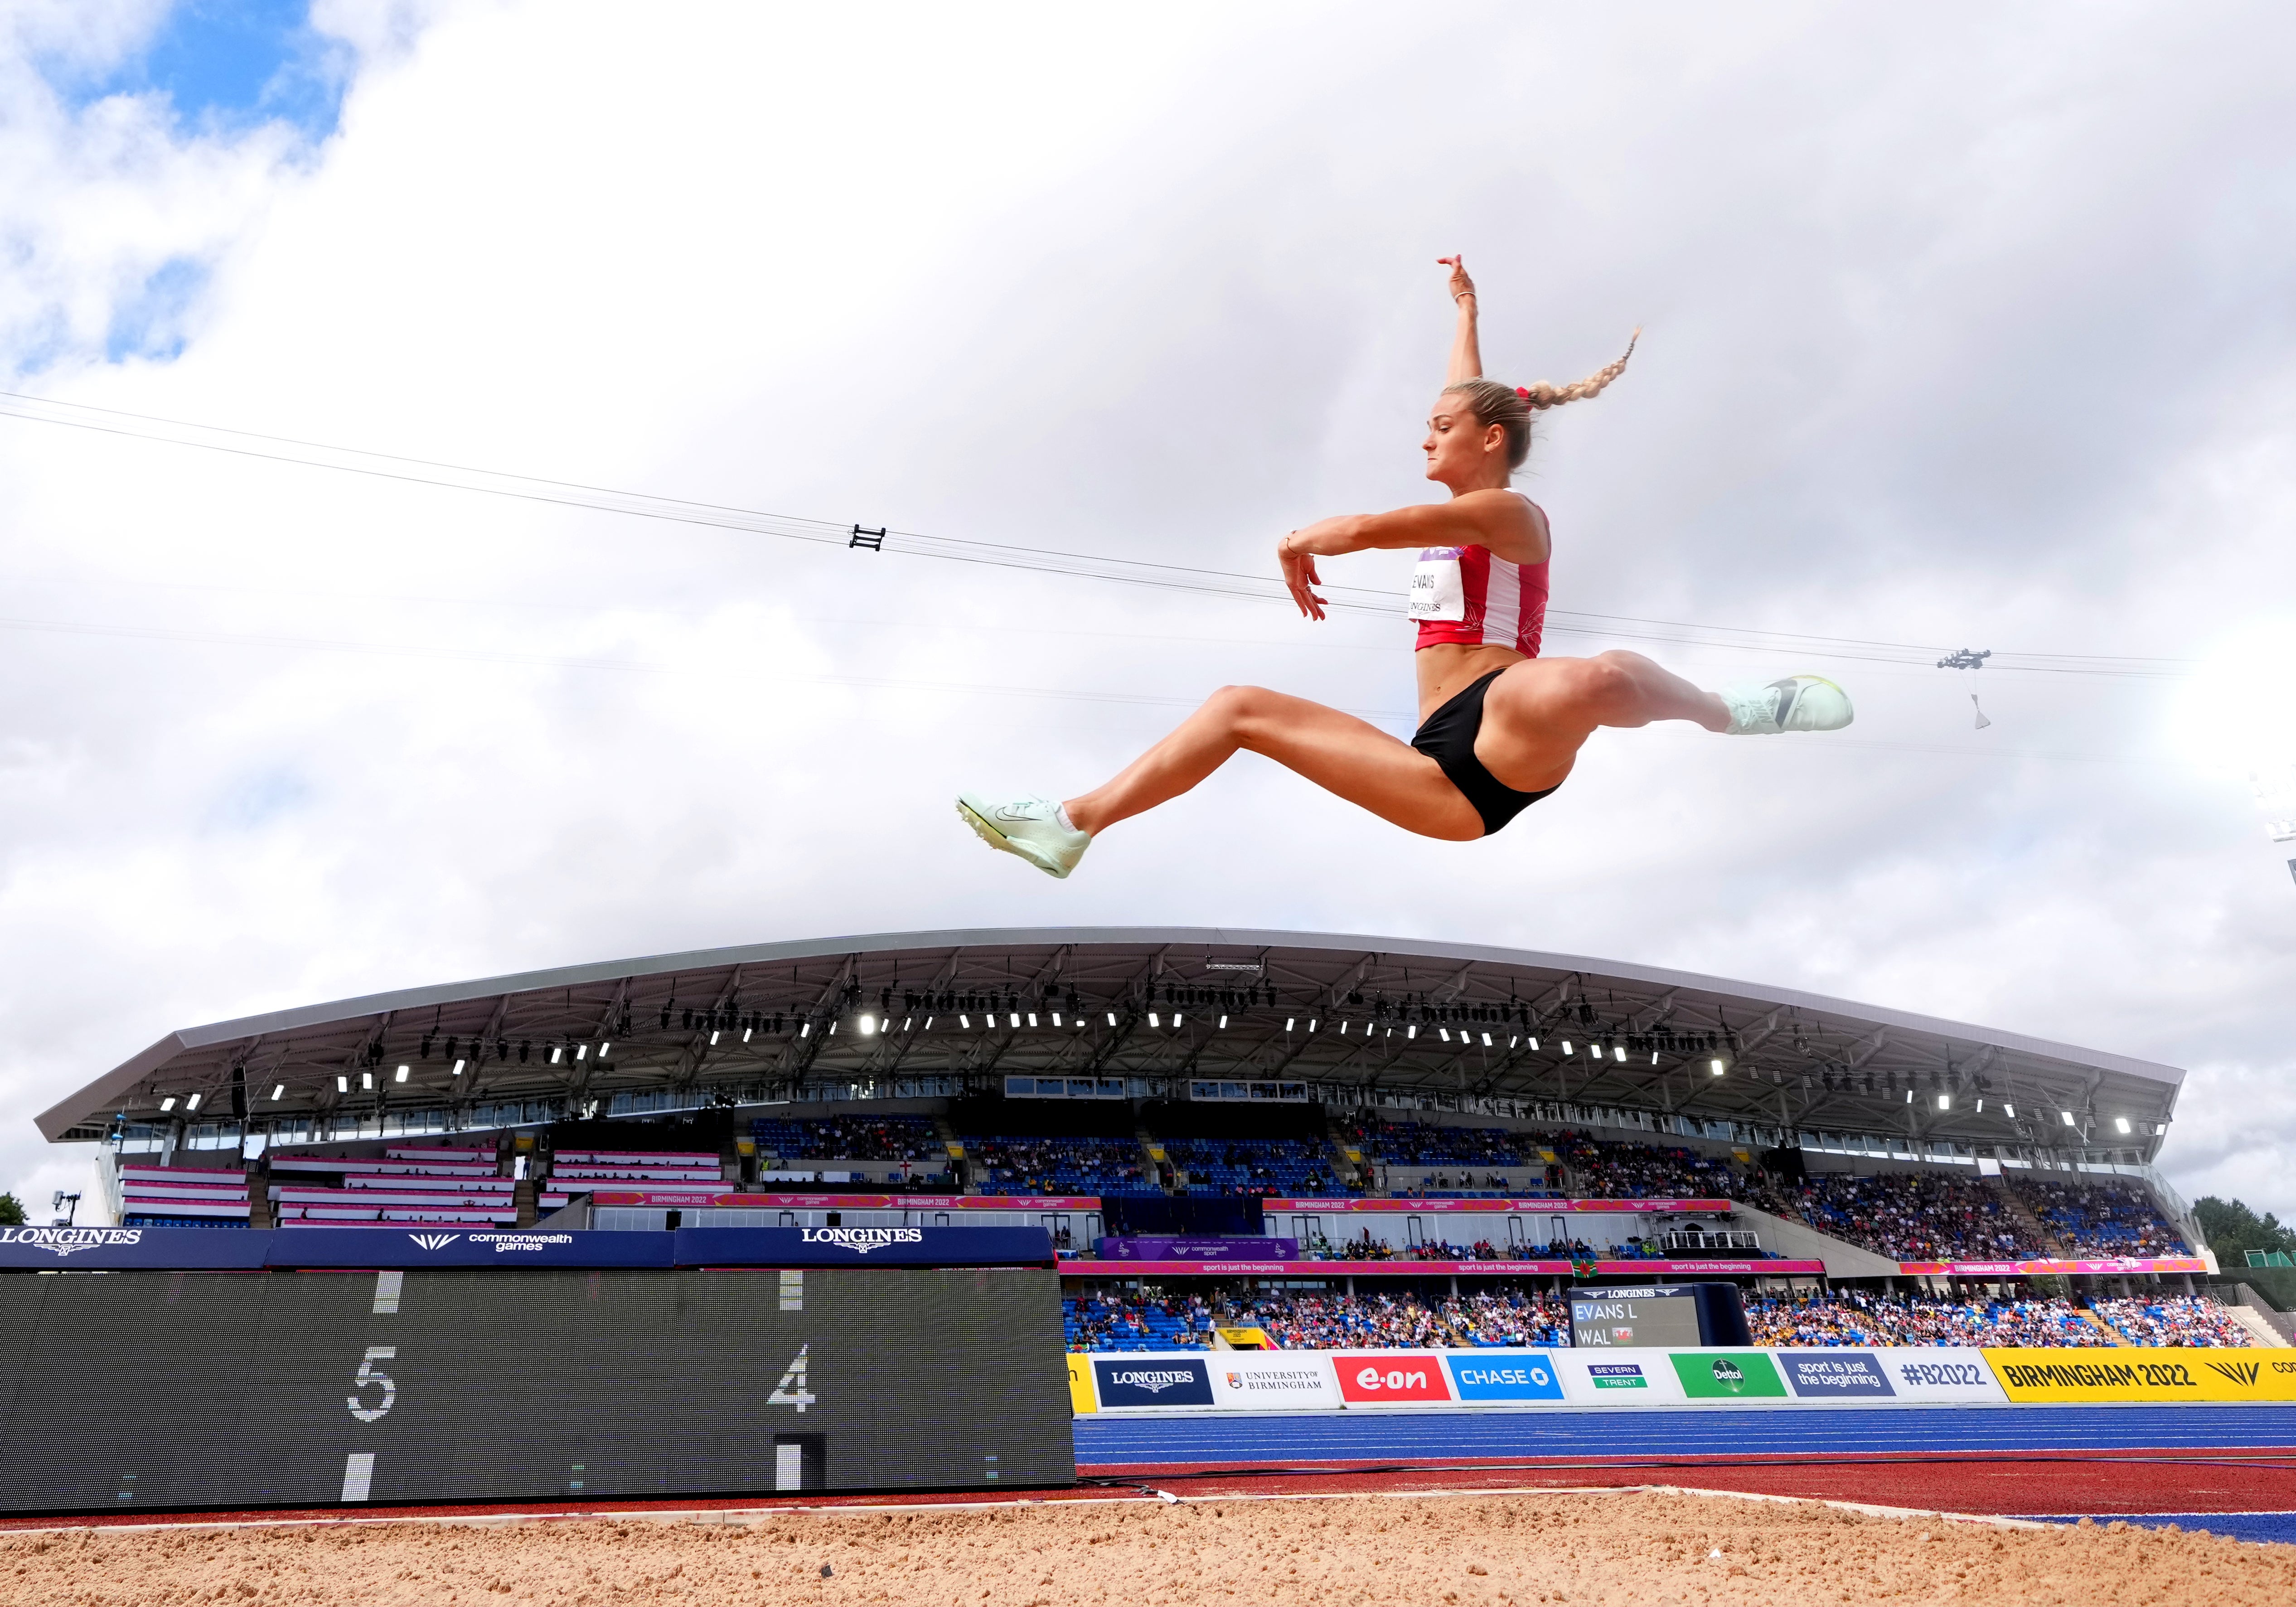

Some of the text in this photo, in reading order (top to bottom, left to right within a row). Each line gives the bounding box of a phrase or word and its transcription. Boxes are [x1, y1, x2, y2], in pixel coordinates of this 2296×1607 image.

[1412, 575, 1434, 589] EVANS
[0, 1228, 142, 1244] LONGINES
[469, 1234, 572, 1243] commonwealth
[802, 1229, 922, 1242] LONGINES
[495, 1242, 543, 1252] games
[1608, 1289, 1655, 1298] LONGINES
[1575, 1304, 1637, 1320] EVANS L
[1578, 1329, 1611, 1345] WAL
[1713, 1370, 1743, 1379] Dettol
[1798, 1361, 1869, 1375] sport is just
[1900, 1364, 1987, 1385] #B2022
[767, 1344, 815, 1412] 4
[1112, 1371, 1194, 1384] LONGINES
[1245, 1371, 1310, 1380] UNIVERSITY
[1461, 1370, 1530, 1384] CHASE
[1797, 1374, 1881, 1387] the beginning
[2002, 1364, 2142, 1387] BIRMINGHAM
[2138, 1364, 2197, 1386] 2022
[348, 1346, 397, 1422] 5
[1248, 1381, 1322, 1389] BIRMINGHAM
